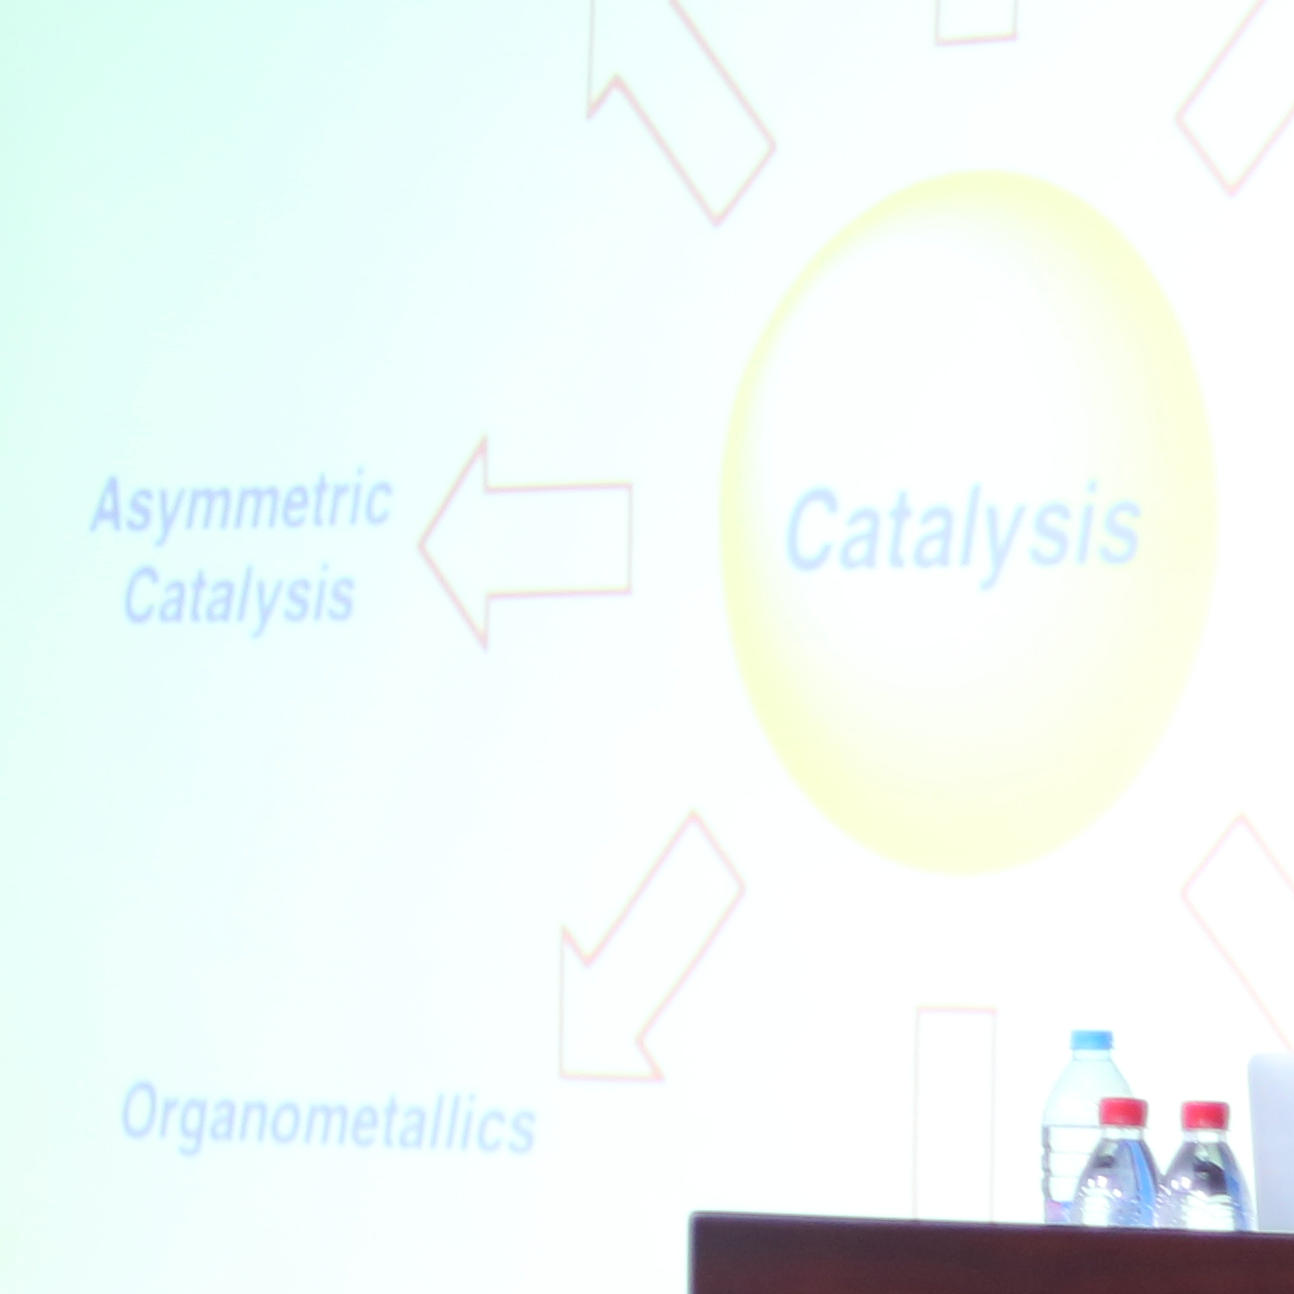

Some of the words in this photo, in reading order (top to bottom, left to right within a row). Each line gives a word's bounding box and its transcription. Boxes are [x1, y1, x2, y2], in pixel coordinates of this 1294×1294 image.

[89, 467, 394, 547] Asymmetric
[786, 478, 1142, 591] Catalysis
[122, 562, 356, 639] Catalysis
[121, 1080, 536, 1157] Organometallics
